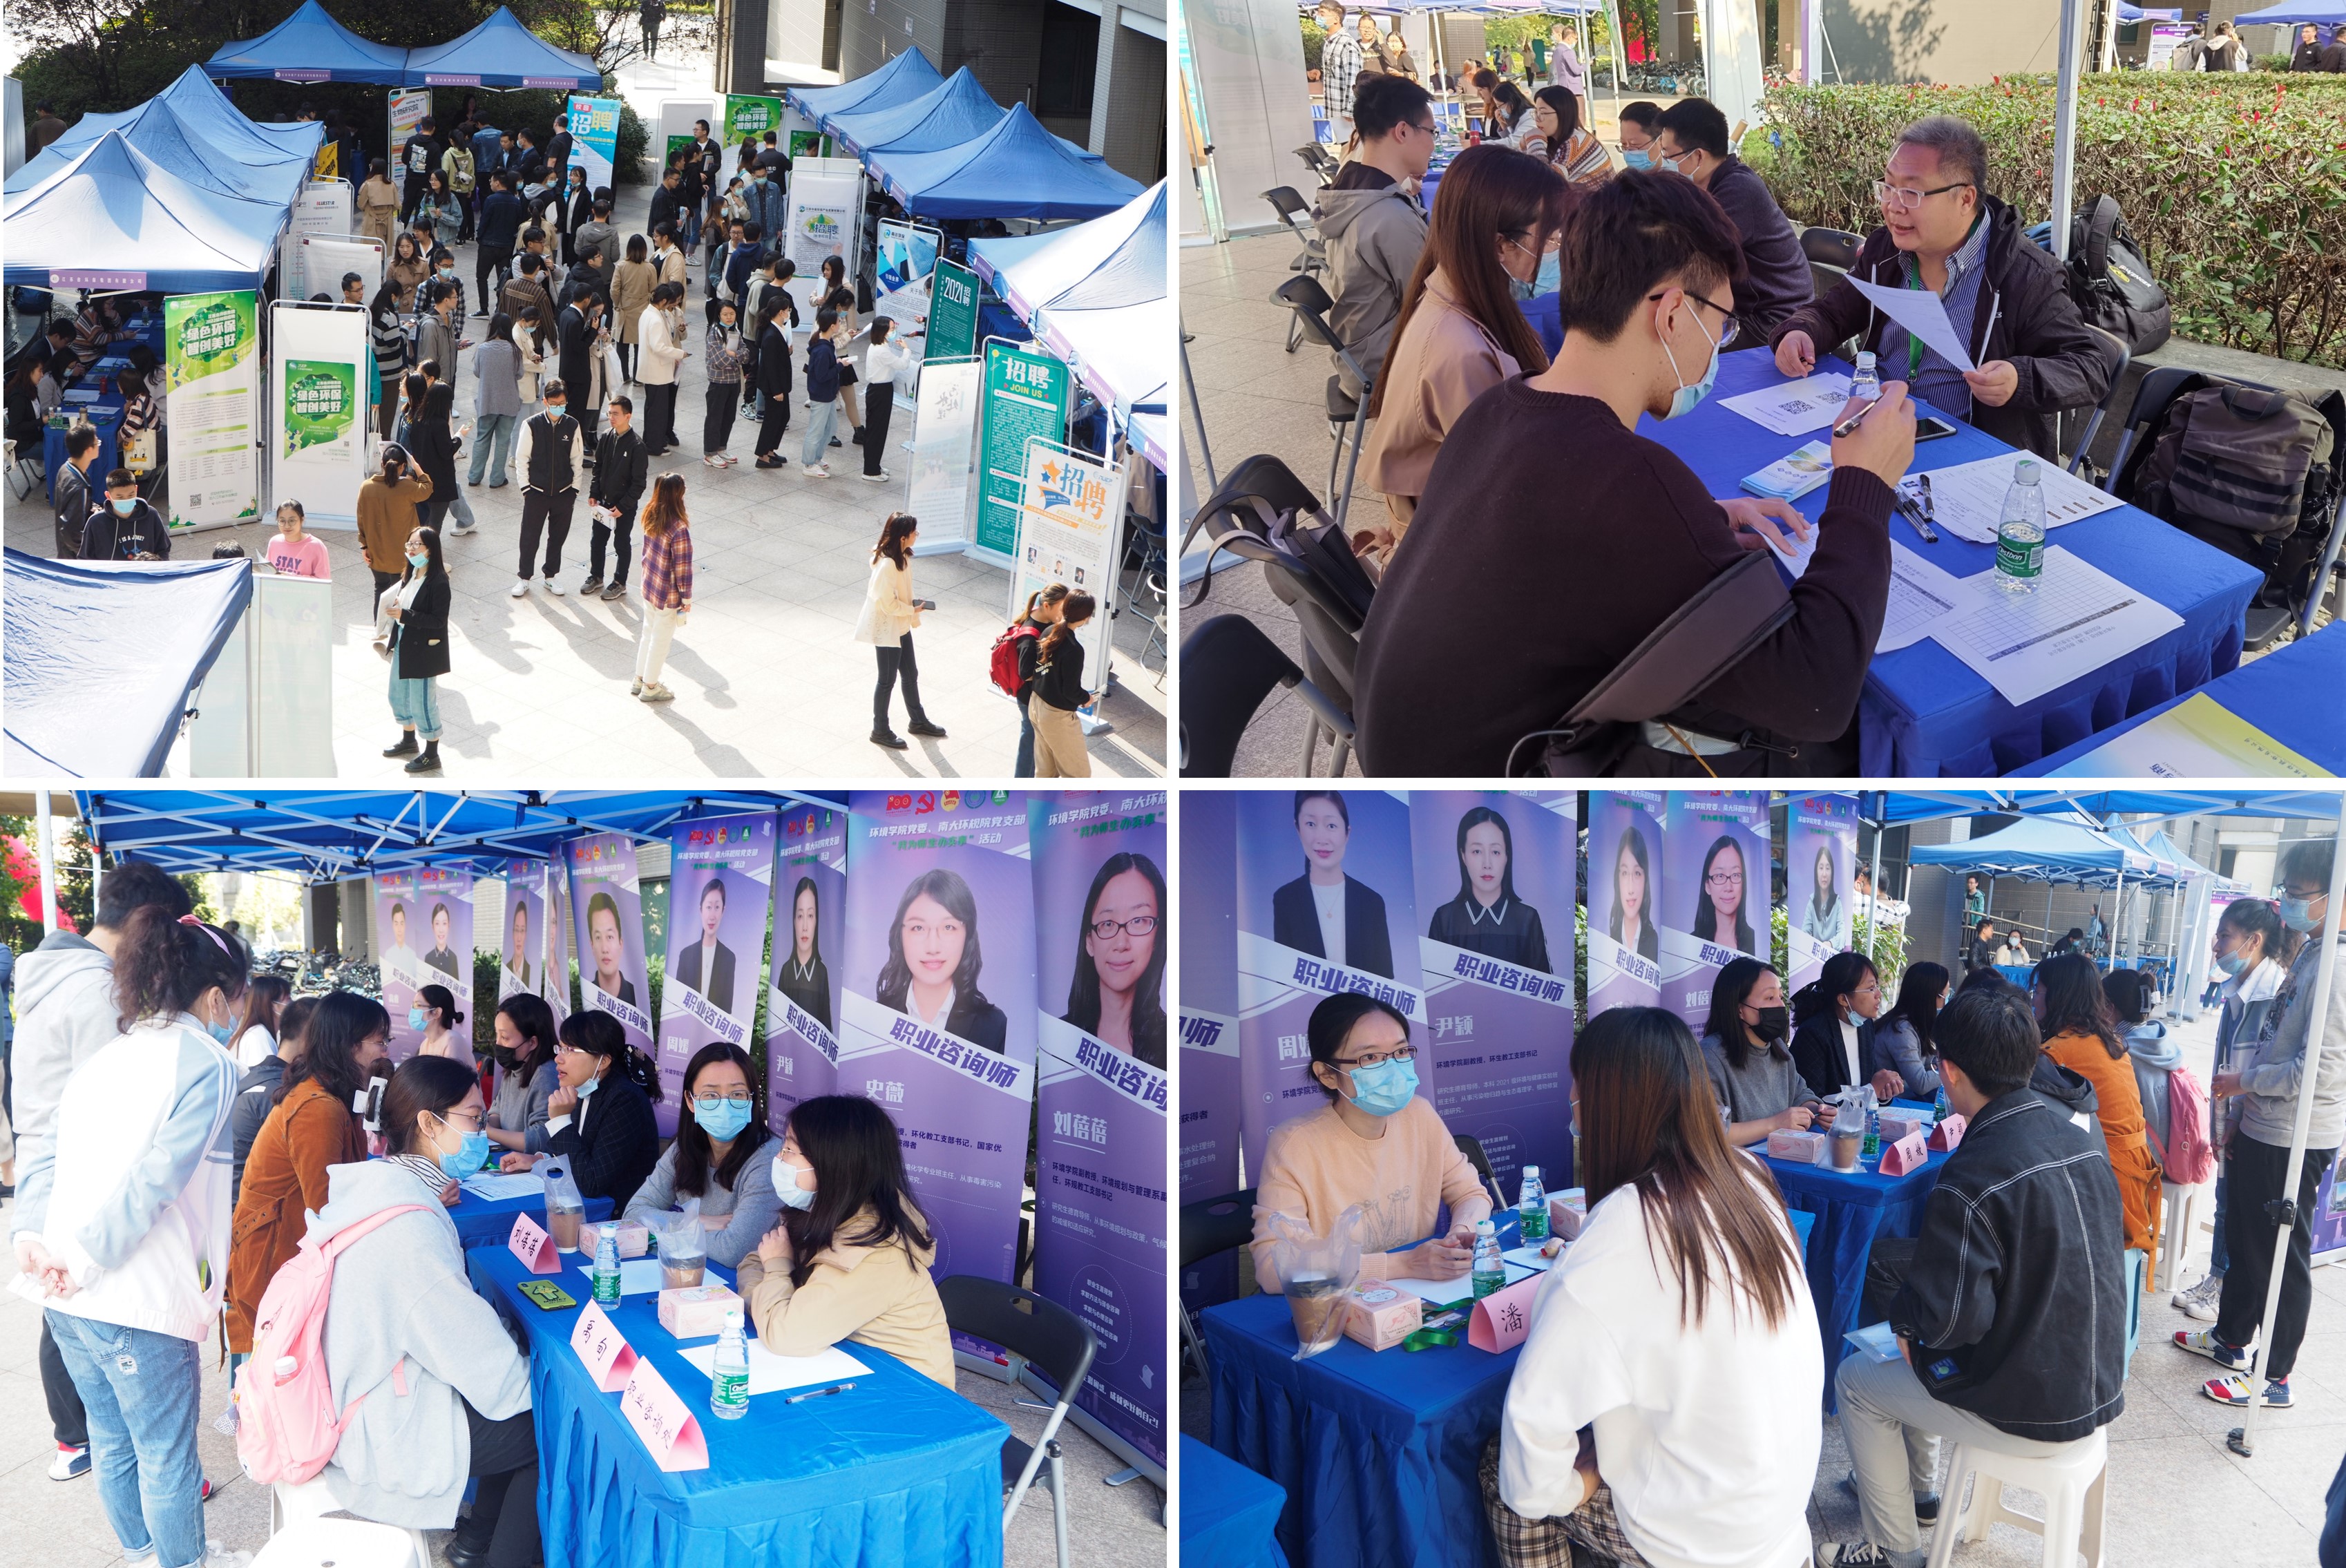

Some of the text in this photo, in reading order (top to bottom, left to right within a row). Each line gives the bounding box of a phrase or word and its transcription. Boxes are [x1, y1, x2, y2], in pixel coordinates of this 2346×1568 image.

[571, 111, 612, 134] 招聘
[815, 223, 839, 240] 招聘
[2125, 268, 2152, 288] WENGER
[944, 277, 964, 304] 2021
[963, 285, 971, 307] 招聘
[187, 319, 236, 342] 绿色环保
[187, 334, 236, 356] 智创美好
[1002, 357, 1053, 390] 招聘
[297, 390, 342, 401] 绿色环保
[1010, 383, 1042, 399] JOIN US
[297, 401, 341, 413] 智创美好
[1060, 463, 1107, 520] 招聘
[275, 555, 303, 570] STAY
[978, 832, 1002, 845] 活动
[393, 968, 418, 993] 职业咨询
[432, 970, 468, 997] 职业咨询师
[1453, 953, 1565, 1003] 职业咨询师
[1685, 990, 1713, 1008] 刘蓓
[596, 991, 648, 1033] 职业咨询师
[683, 991, 745, 1044] 职业咨询师
[666, 1035, 689, 1055] 周媛
[786, 1004, 839, 1062] 职业咨询师
[890, 1017, 1020, 1089] 职业咨询师
[866, 1079, 904, 1104] 史薇
[1053, 1111, 1107, 1145] 刘蓓蓓
[1500, 1302, 1523, 1333] 潘
